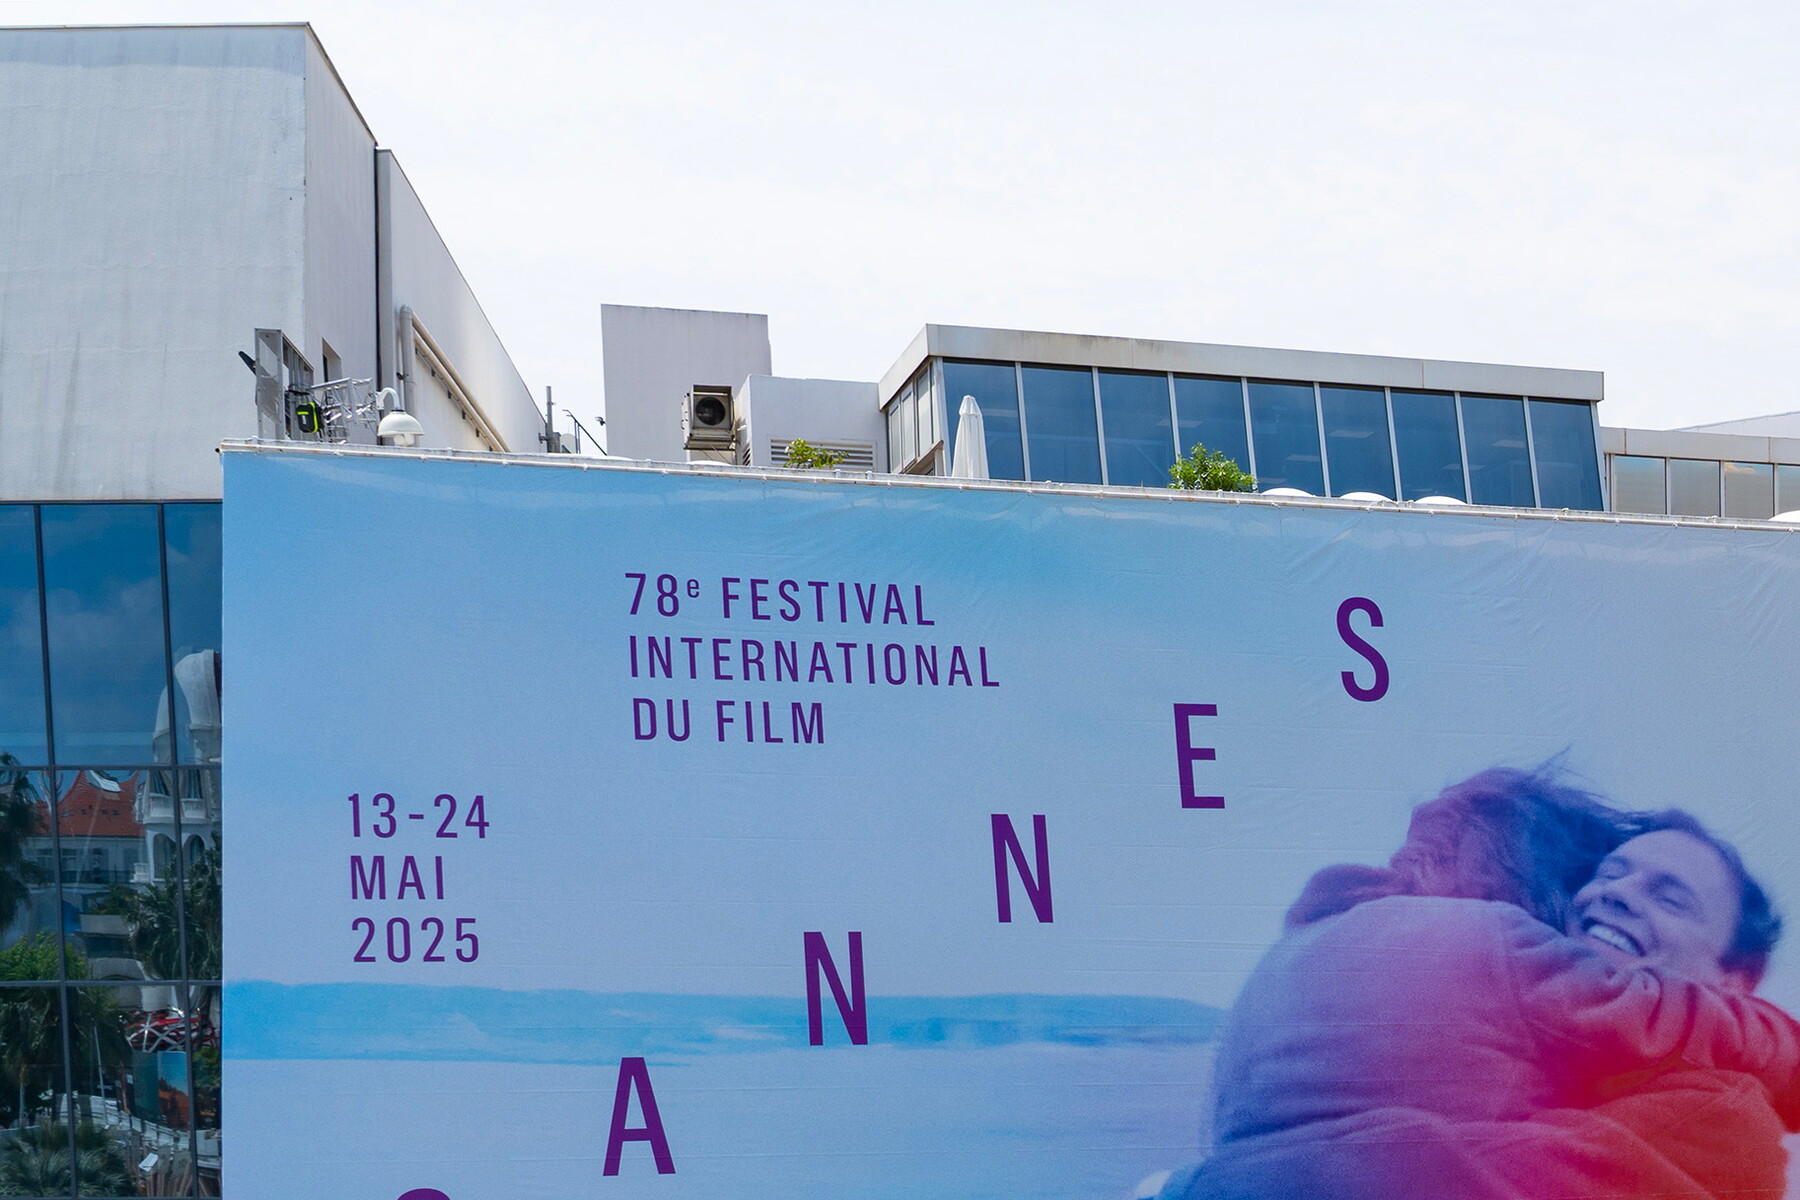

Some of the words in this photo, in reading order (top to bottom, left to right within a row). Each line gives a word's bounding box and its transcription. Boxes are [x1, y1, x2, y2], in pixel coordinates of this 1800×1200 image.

[721, 577, 935, 626] FESTIVAL
[629, 635, 1000, 687] INTERNATIONAL
[632, 697, 690, 742] DU
[716, 700, 824, 744] FILM
[348, 793, 490, 839] 13-24
[350, 855, 444, 900] MAI
[351, 917, 479, 963] 2025
